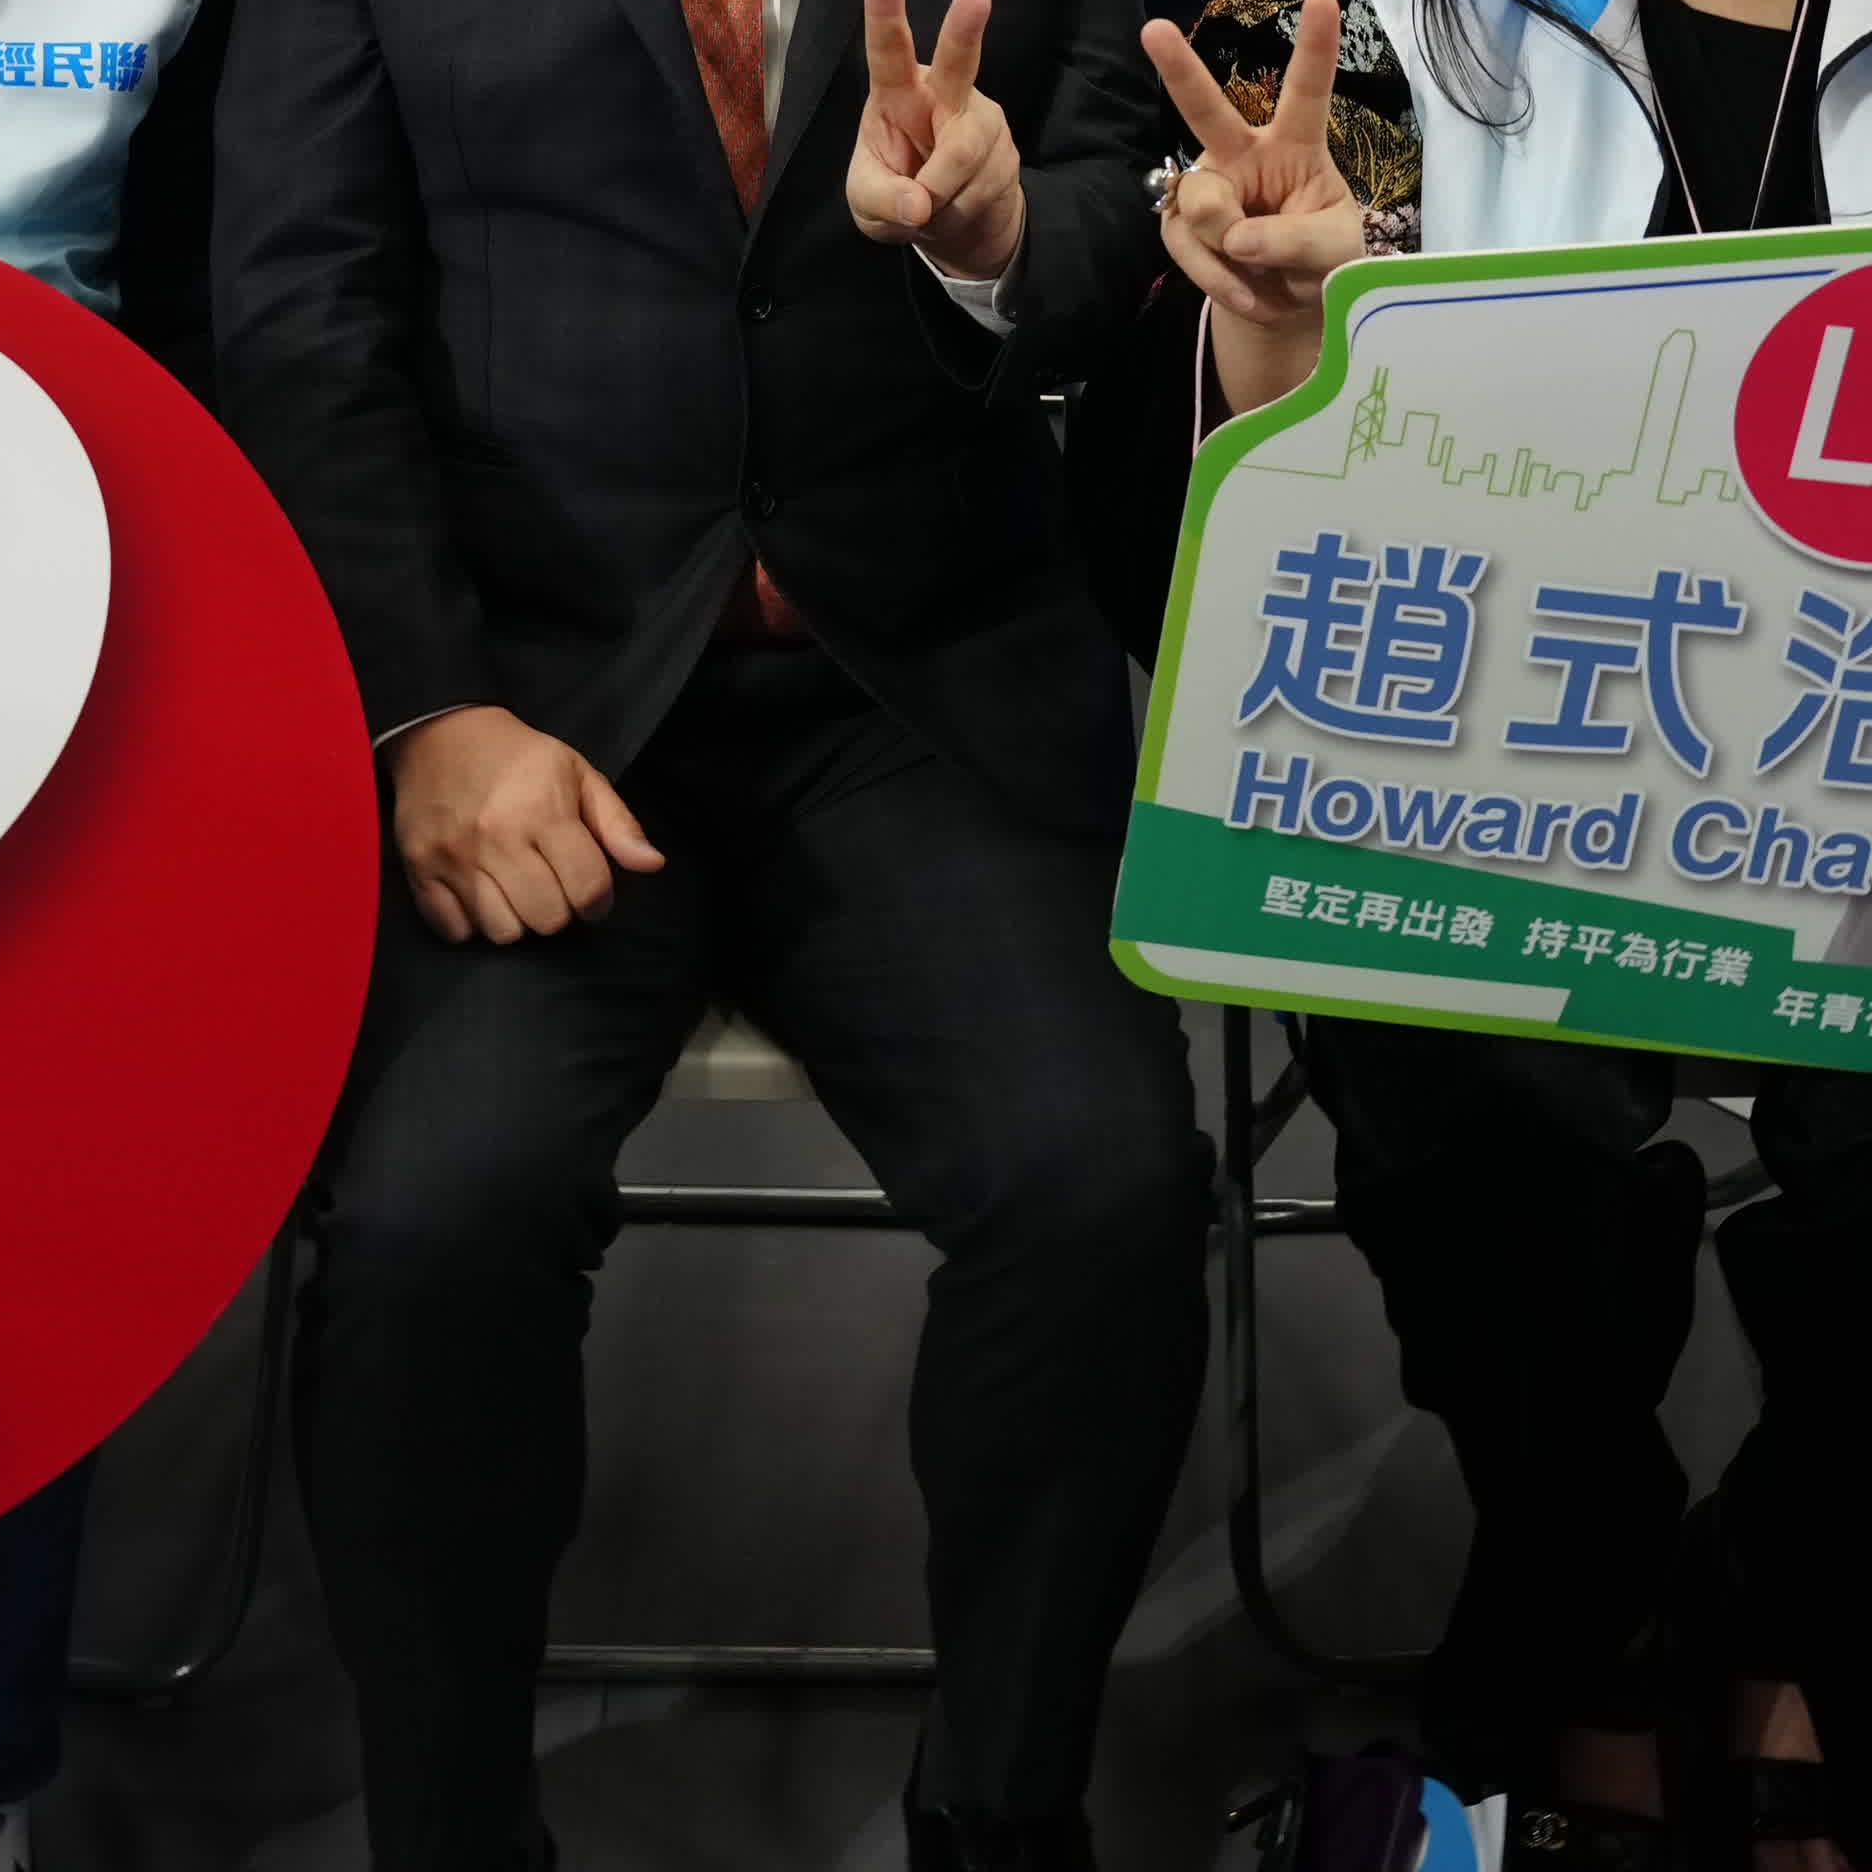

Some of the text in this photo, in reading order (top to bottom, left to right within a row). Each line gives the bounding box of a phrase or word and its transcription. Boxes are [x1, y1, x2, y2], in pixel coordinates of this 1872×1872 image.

[1226, 750, 1642, 870] Howard
[1260, 875, 1754, 988] 堅定再出發 持平為行業
